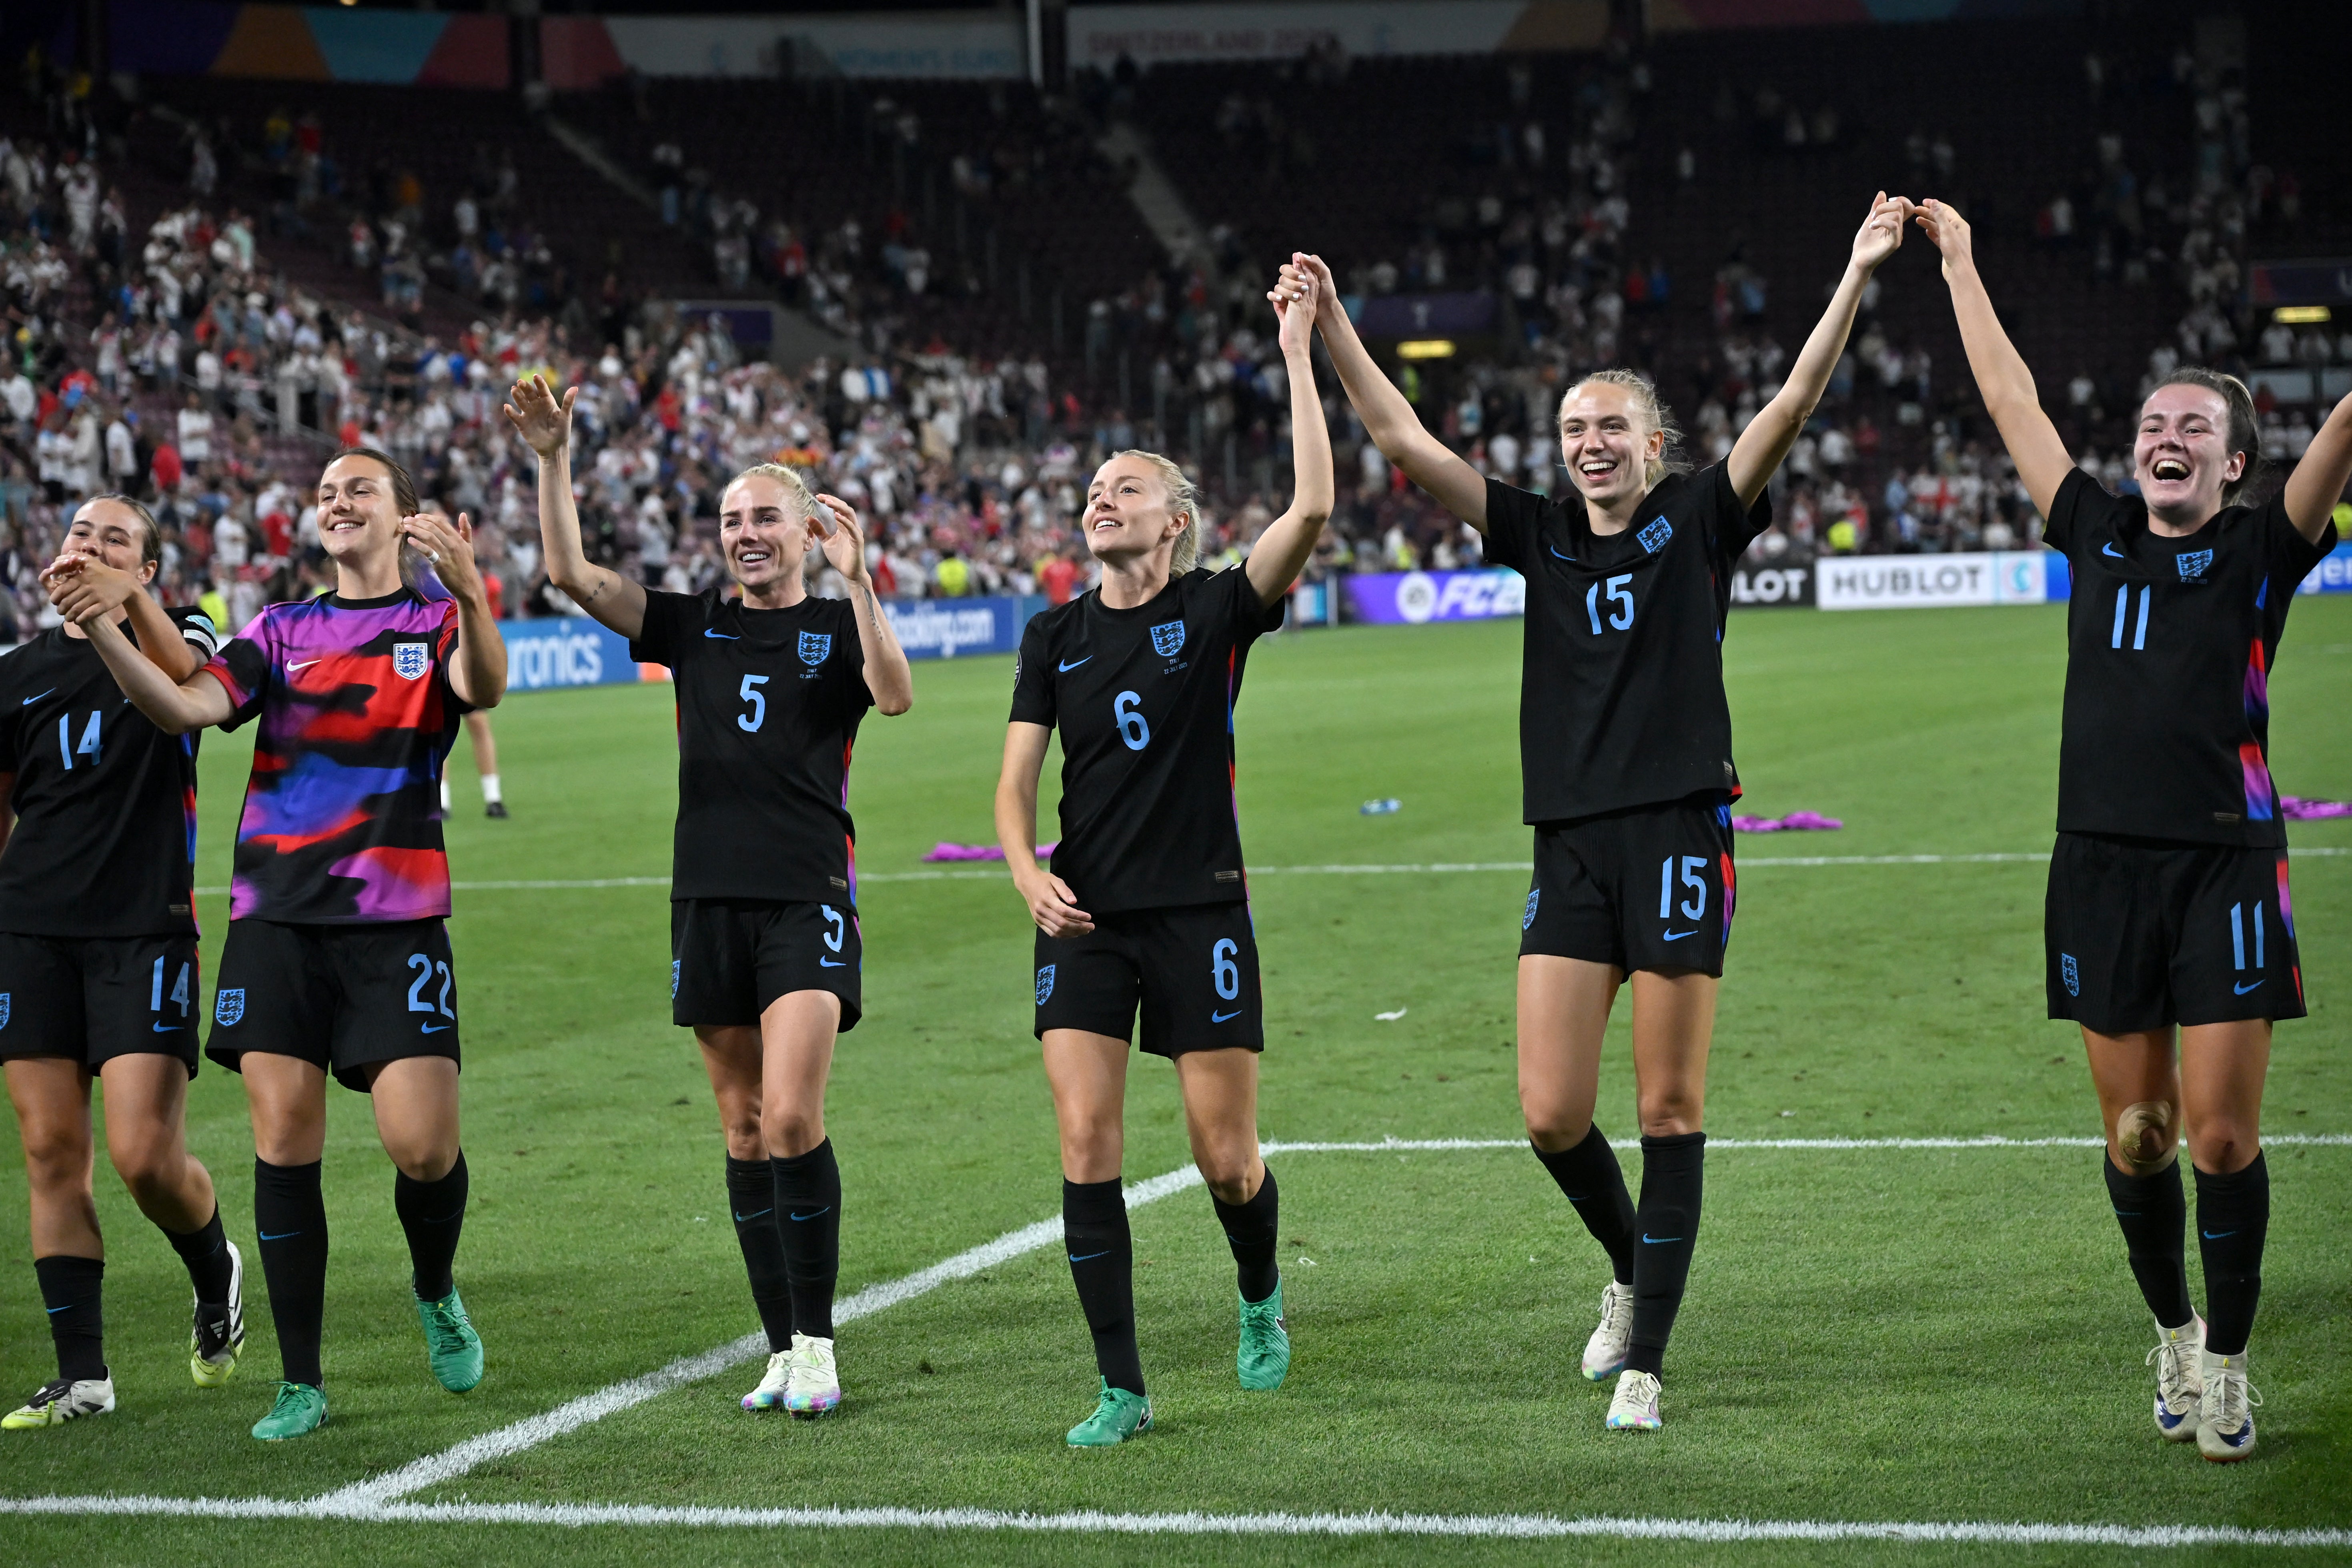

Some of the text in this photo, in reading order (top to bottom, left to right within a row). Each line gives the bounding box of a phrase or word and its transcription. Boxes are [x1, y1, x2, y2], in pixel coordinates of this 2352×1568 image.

[1586, 573, 1635, 635] 15
[1731, 569, 1807, 603] LOT
[1833, 565, 1981, 597] HUBLOT
[2112, 583, 2150, 650] 11
[737, 674, 770, 733] 5
[1114, 690, 1150, 751] 6
[59, 710, 103, 770] 14
[1659, 855, 1708, 921] 15
[820, 904, 844, 953] 5
[2230, 900, 2264, 970] 11
[150, 955, 190, 1018] 14
[407, 953, 455, 1020] 22
[1211, 937, 1239, 1000] 6
